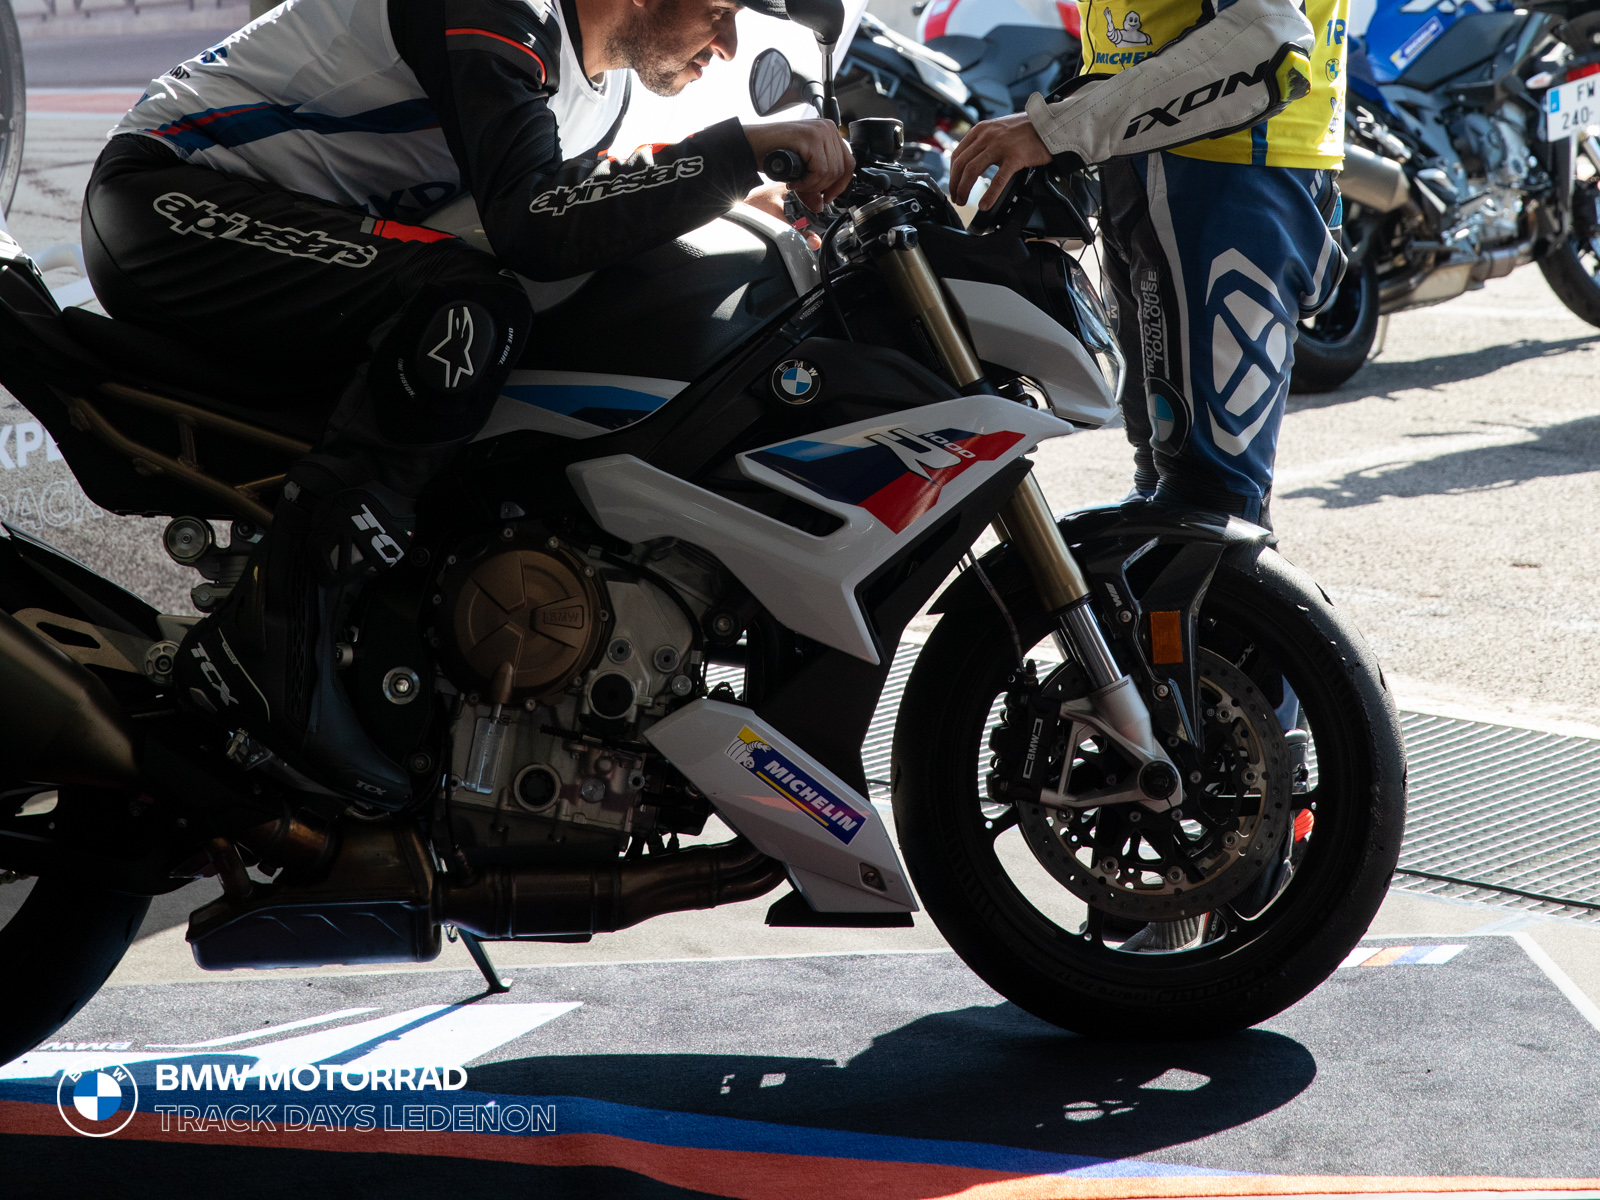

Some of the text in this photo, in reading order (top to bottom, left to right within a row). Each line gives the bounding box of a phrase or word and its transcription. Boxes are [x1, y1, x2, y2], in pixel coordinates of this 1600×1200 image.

[527, 155, 705, 217] alpinestars
[153, 192, 378, 268] alpinestars
[1141, 280, 1155, 373] MOTO RIDE
[1148, 270, 1163, 361] TOULOUSE
[778, 360, 819, 377] BMW
[923, 432, 976, 459] 1000
[190, 642, 239, 706] TCX
[1026, 733, 1040, 761] BMW
[356, 779, 387, 796] TCX
[763, 759, 858, 832] MICHELIN
